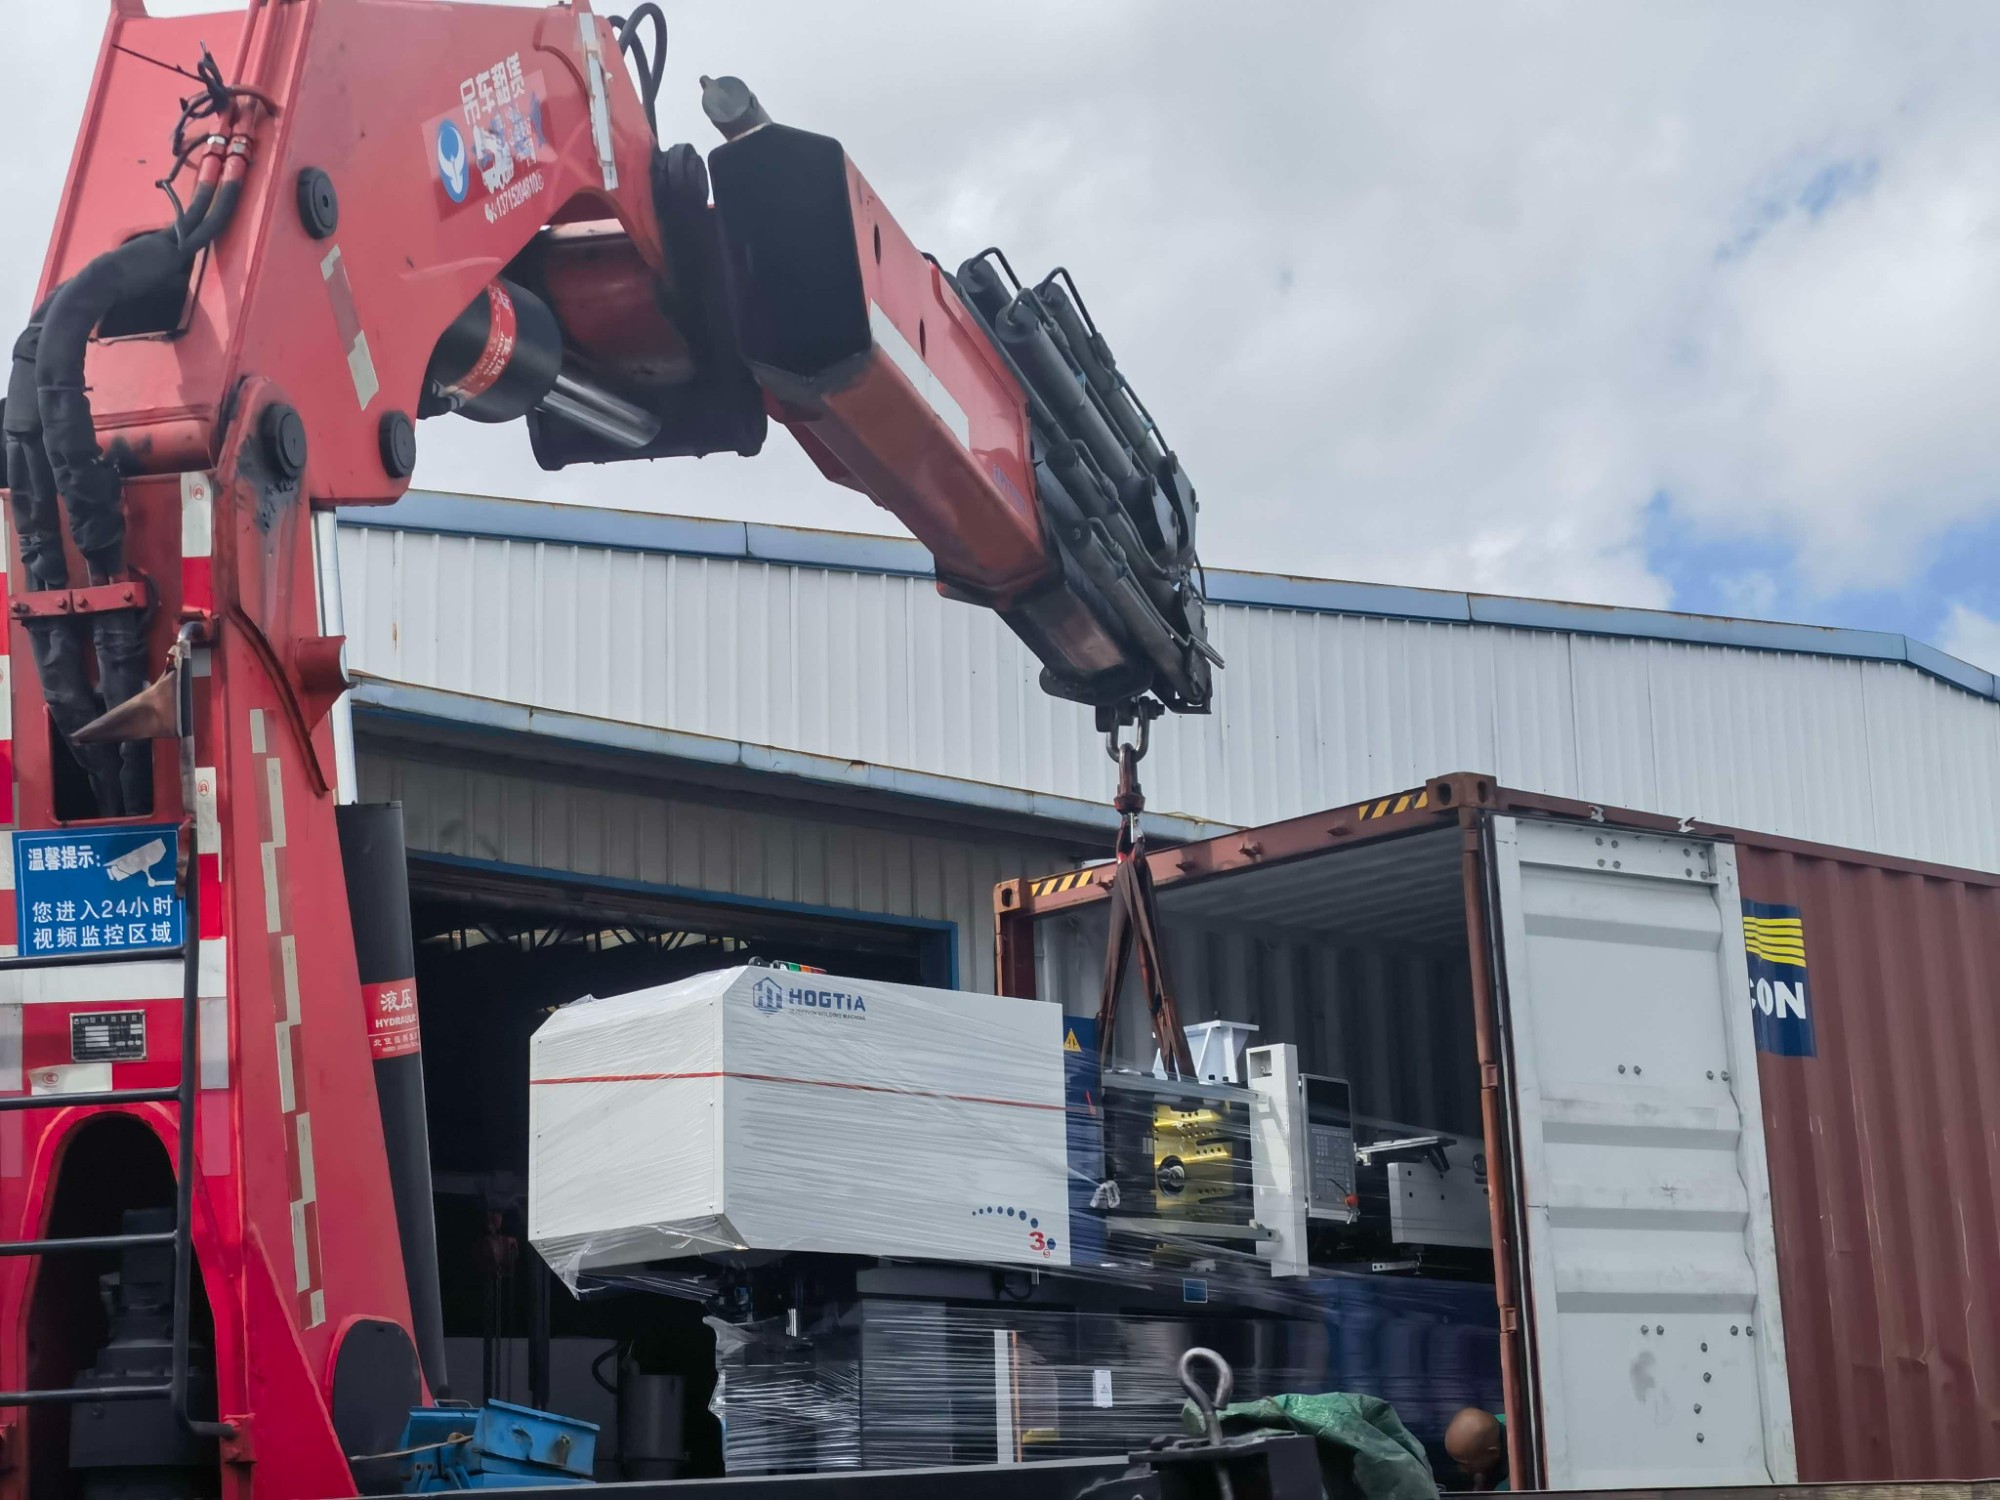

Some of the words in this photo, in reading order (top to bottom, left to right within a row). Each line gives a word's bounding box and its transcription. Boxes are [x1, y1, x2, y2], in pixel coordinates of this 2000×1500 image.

[460, 52, 525, 125] 吊车租赁
[28, 845, 101, 871] 温馨提示:
[32, 895, 173, 923] 您进入24小时
[34, 921, 172, 950] 视频监控区域
[380, 989, 413, 1012] 液压
[789, 988, 866, 1012] HOGTIA
[1029, 1231, 1046, 1251] 3
